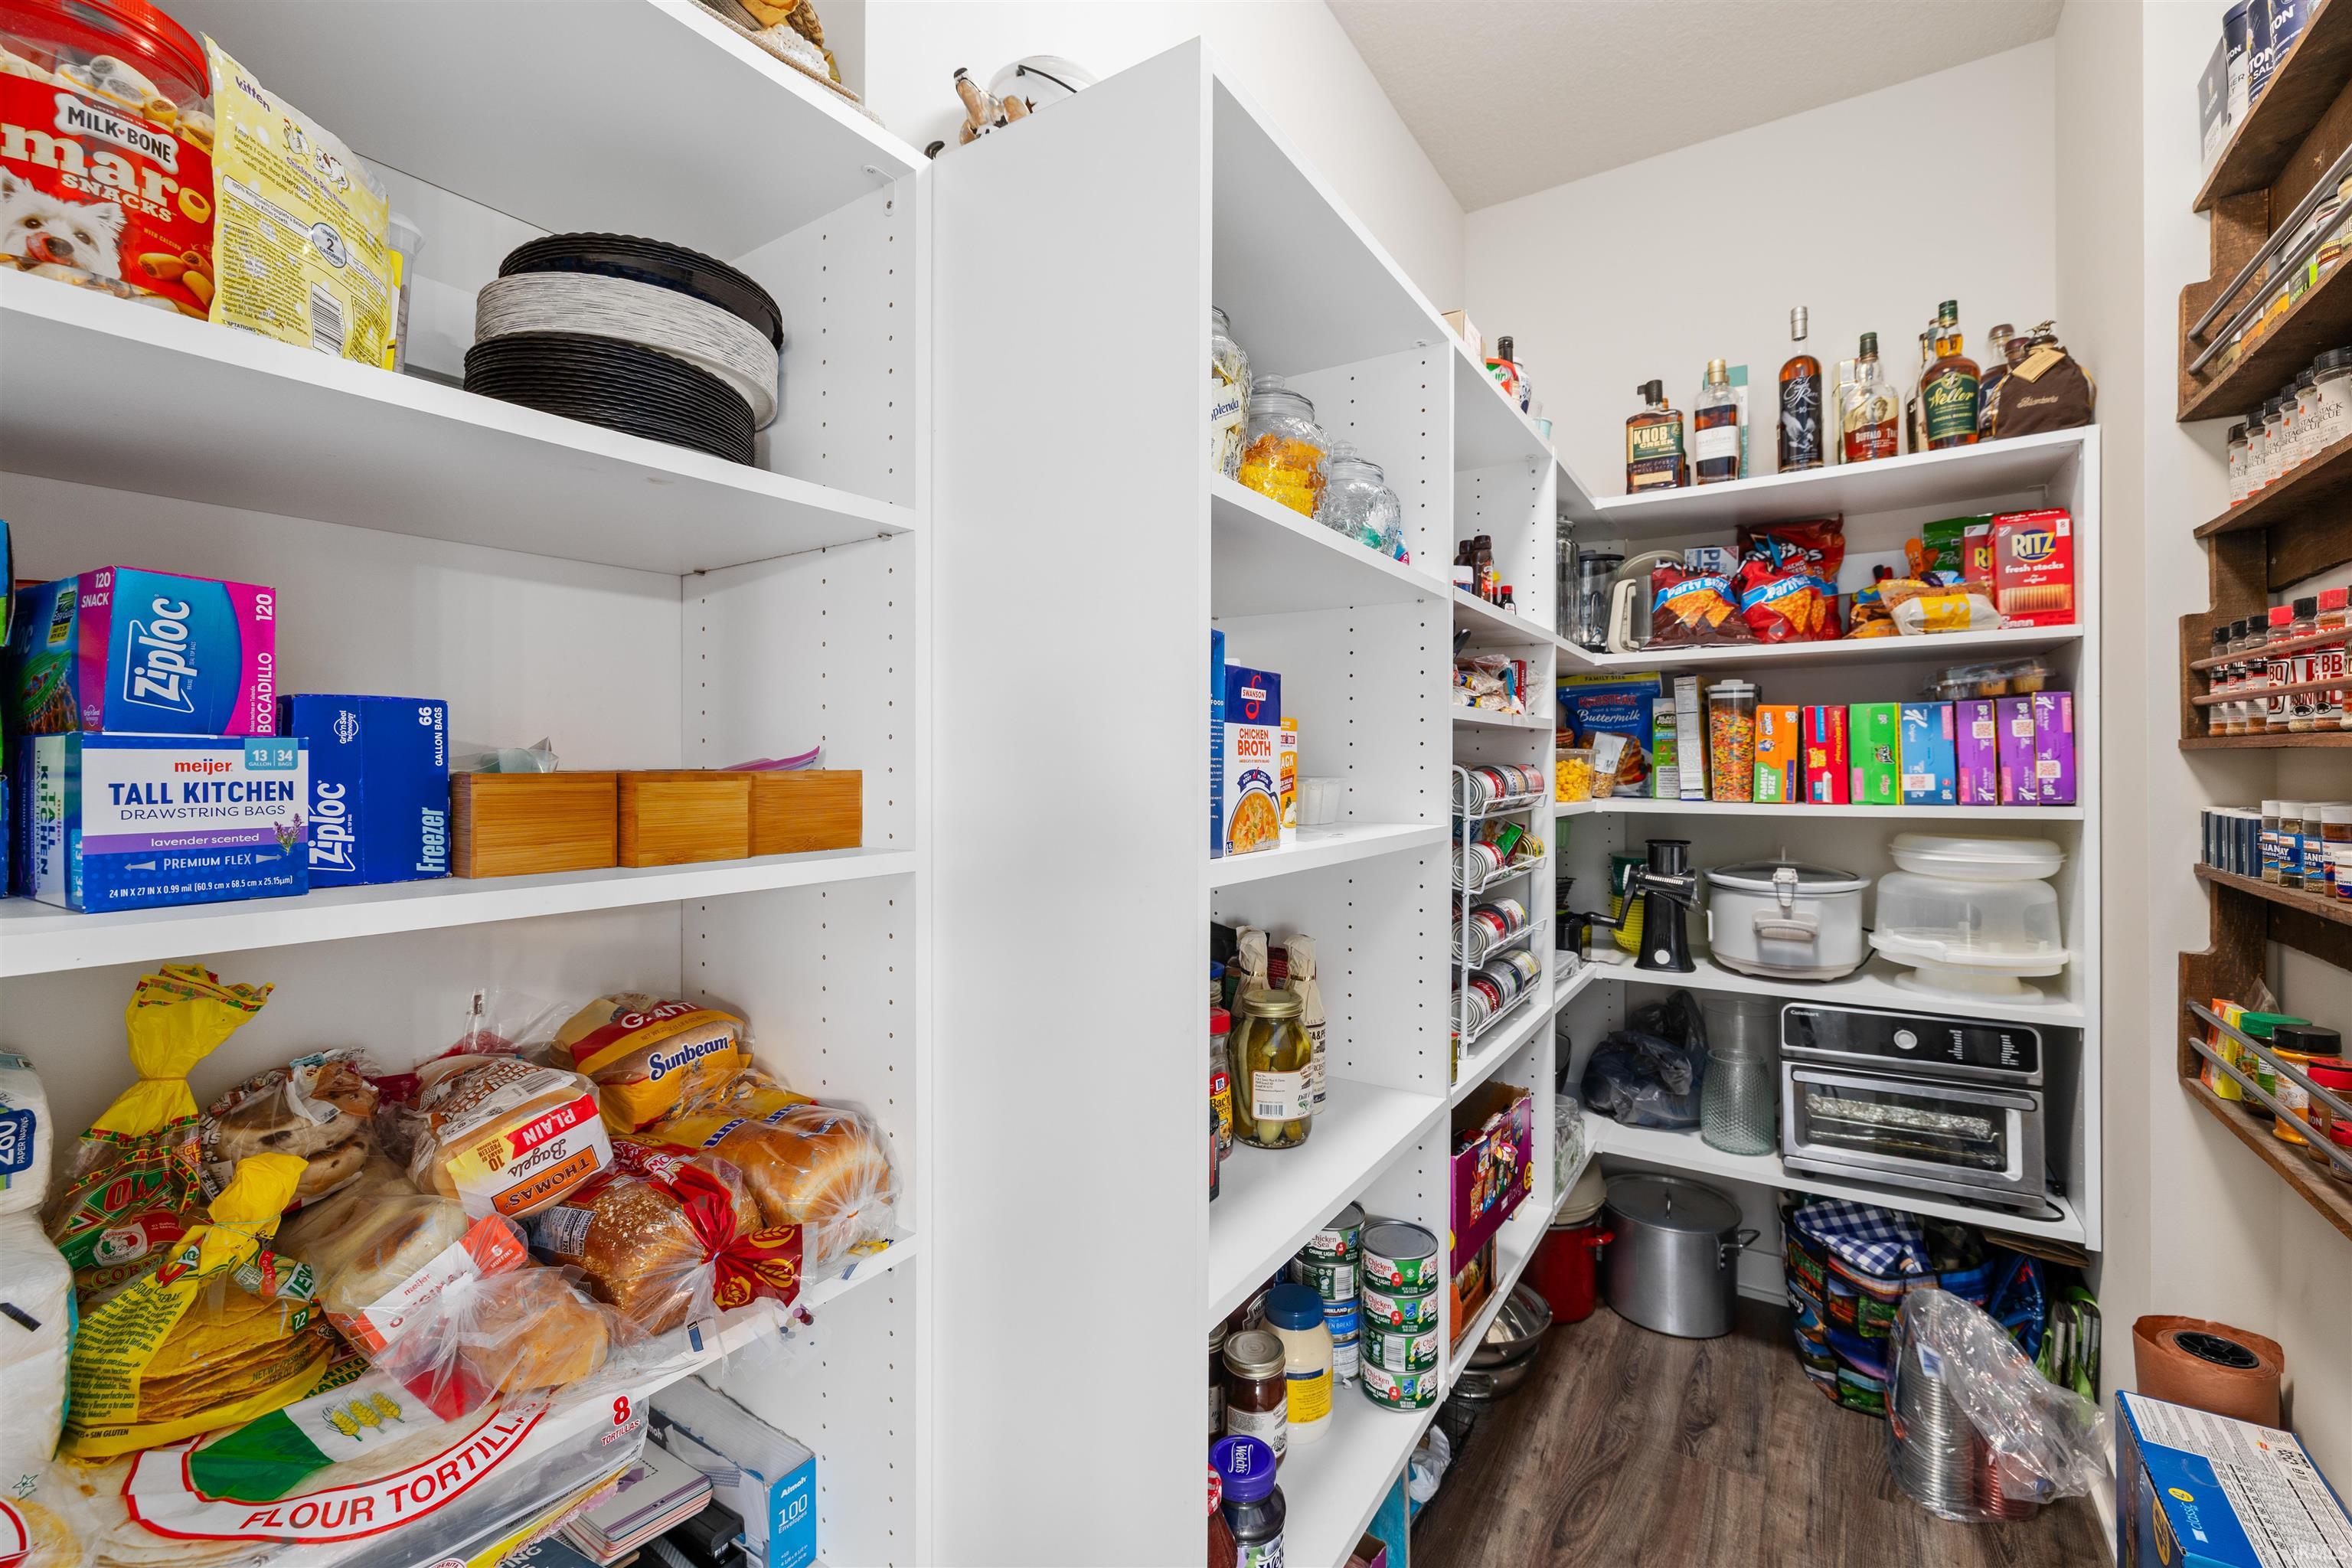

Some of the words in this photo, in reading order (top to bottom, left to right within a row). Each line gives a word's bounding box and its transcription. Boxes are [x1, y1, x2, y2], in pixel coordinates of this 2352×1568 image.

[235, 76, 271, 113] kitten
[67, 106, 120, 139] MILK
[127, 127, 172, 164] BONE
[61, 173, 173, 222] SNACKS
[327, 238, 334, 252] 2
[1634, 426, 1668, 444] KNOB
[1639, 439, 1674, 448] CREEK
[2011, 532, 2056, 557] RITZ
[2004, 564, 2030, 573] fresh
[2033, 560, 2064, 570] stacks
[96, 572, 111, 588] 120
[1667, 580, 1702, 598] Party
[81, 593, 109, 608] SNACK
[256, 593, 273, 621] 120
[134, 598, 198, 701] Ziploc
[256, 652, 273, 733] BOCADILLO
[1243, 689, 1266, 698] SWANSON
[1579, 694, 1637, 708] KRUSTEAZ
[418, 707, 433, 726] 66
[434, 707, 443, 730] BAGS
[1577, 709, 1640, 723] Buttermilk
[348, 712, 356, 742] Technology
[1240, 728, 1269, 740] CHICKEN
[252, 750, 268, 761] 13
[277, 750, 292, 761] 34
[435, 732, 443, 766] GALLON
[1237, 740, 1271, 756] BROTH
[174, 758, 233, 776] meijer
[108, 782, 174, 805] TALL
[183, 781, 294, 804] KITCHEN
[1759, 766, 1768, 800] FAMILY
[1768, 775, 1776, 795] SIZE
[40, 766, 48, 875] KITCHEN
[121, 806, 240, 820] DRAWSTRING
[244, 805, 286, 816] BAGS
[307, 782, 355, 864] Ziploc
[151, 835, 209, 847] lavender
[211, 833, 260, 844] scented
[416, 807, 446, 872] Freezer
[164, 857, 220, 871] PREMIUM
[224, 854, 252, 865] FLEX
[109, 889, 119, 898] 24
[120, 888, 129, 897] IN
[137, 887, 145, 896] 27
[163, 885, 179, 894] 0.99
[181, 884, 192, 893] mil
[231, 880, 246, 888] 68.5
[621, 1002, 698, 1028] GANT
[649, 1035, 729, 1081] Sunbeam
[19, 1116, 28, 1142] NAPKINS
[521, 1107, 577, 1146] PLAIN
[17, 1142, 26, 1164] PAPER
[478, 1142, 501, 1158] PROTEIN
[508, 1138, 567, 1178] Bagels
[488, 1155, 505, 1172] 10
[564, 1210, 578, 1233] Calories
[582, 1212, 596, 1238] Nutrition
[490, 1248, 514, 1269] MUFFINS
[491, 1244, 503, 1256] 6
[1368, 1257, 1392, 1271] Chicken
[1374, 1267, 1385, 1276] Sea
[403, 1272, 430, 1296] meijer
[1368, 1295, 1392, 1310] Chicken
[294, 1312, 306, 1330] 22
[1367, 1367, 1390, 1384] Chicken
[1373, 1379, 1383, 1388] Sea
[1377, 1390, 1389, 1400] LIGHT
[612, 1395, 632, 1426] 8
[90, 1430, 103, 1439] SIN
[103, 1429, 129, 1437] GLUTEN
[601, 1417, 641, 1447] TORTILLAS
[239, 1495, 374, 1530] FLOUR
[386, 1403, 534, 1514] TORTILL
[1235, 1444, 1247, 1474] Welch's
[780, 1475, 808, 1499] Aimoh
[779, 1494, 808, 1527] 100
[779, 1511, 808, 1534] Envelopes
